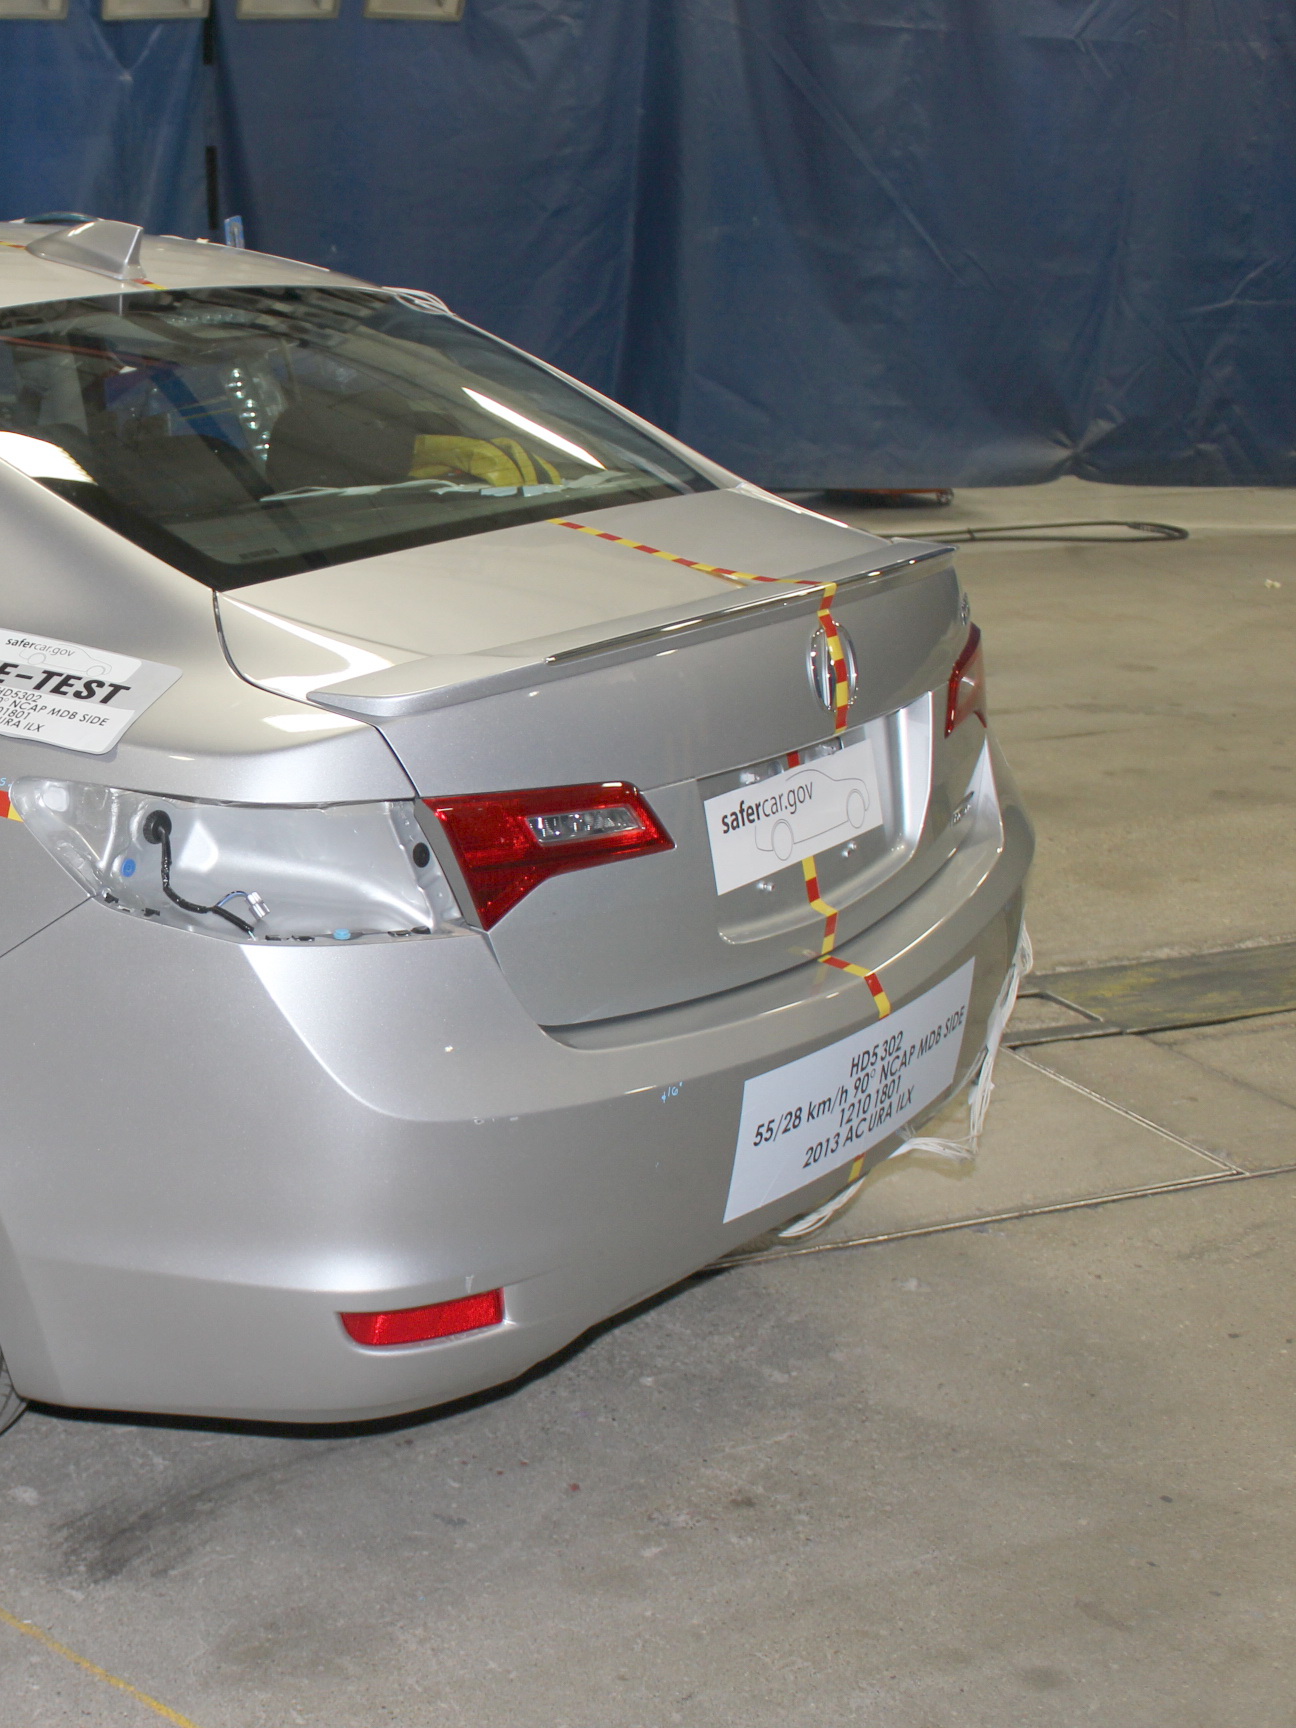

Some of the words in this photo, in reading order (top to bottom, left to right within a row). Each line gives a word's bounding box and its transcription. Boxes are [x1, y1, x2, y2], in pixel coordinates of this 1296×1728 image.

[5, 638, 76, 657] safercar.gov
[8, 700, 47, 713] NCAP
[47, 708, 78, 720] MDB
[79, 713, 110, 727] SIDE
[23, 722, 45, 732] ILX
[721, 781, 813, 834] safercar.gov
[753, 1106, 803, 1147] 55/28
[806, 1085, 849, 1123] km/h
[853, 1068, 876, 1098] 90°
[879, 1044, 916, 1084] NCAP
[917, 1025, 942, 1059] MDB
[943, 1005, 965, 1038] SIDE
[850, 1030, 904, 1078] HD5302
[802, 1131, 841, 1169] 2013
[843, 1100, 893, 1148] ACURA
[895, 1084, 915, 1114] ILX
